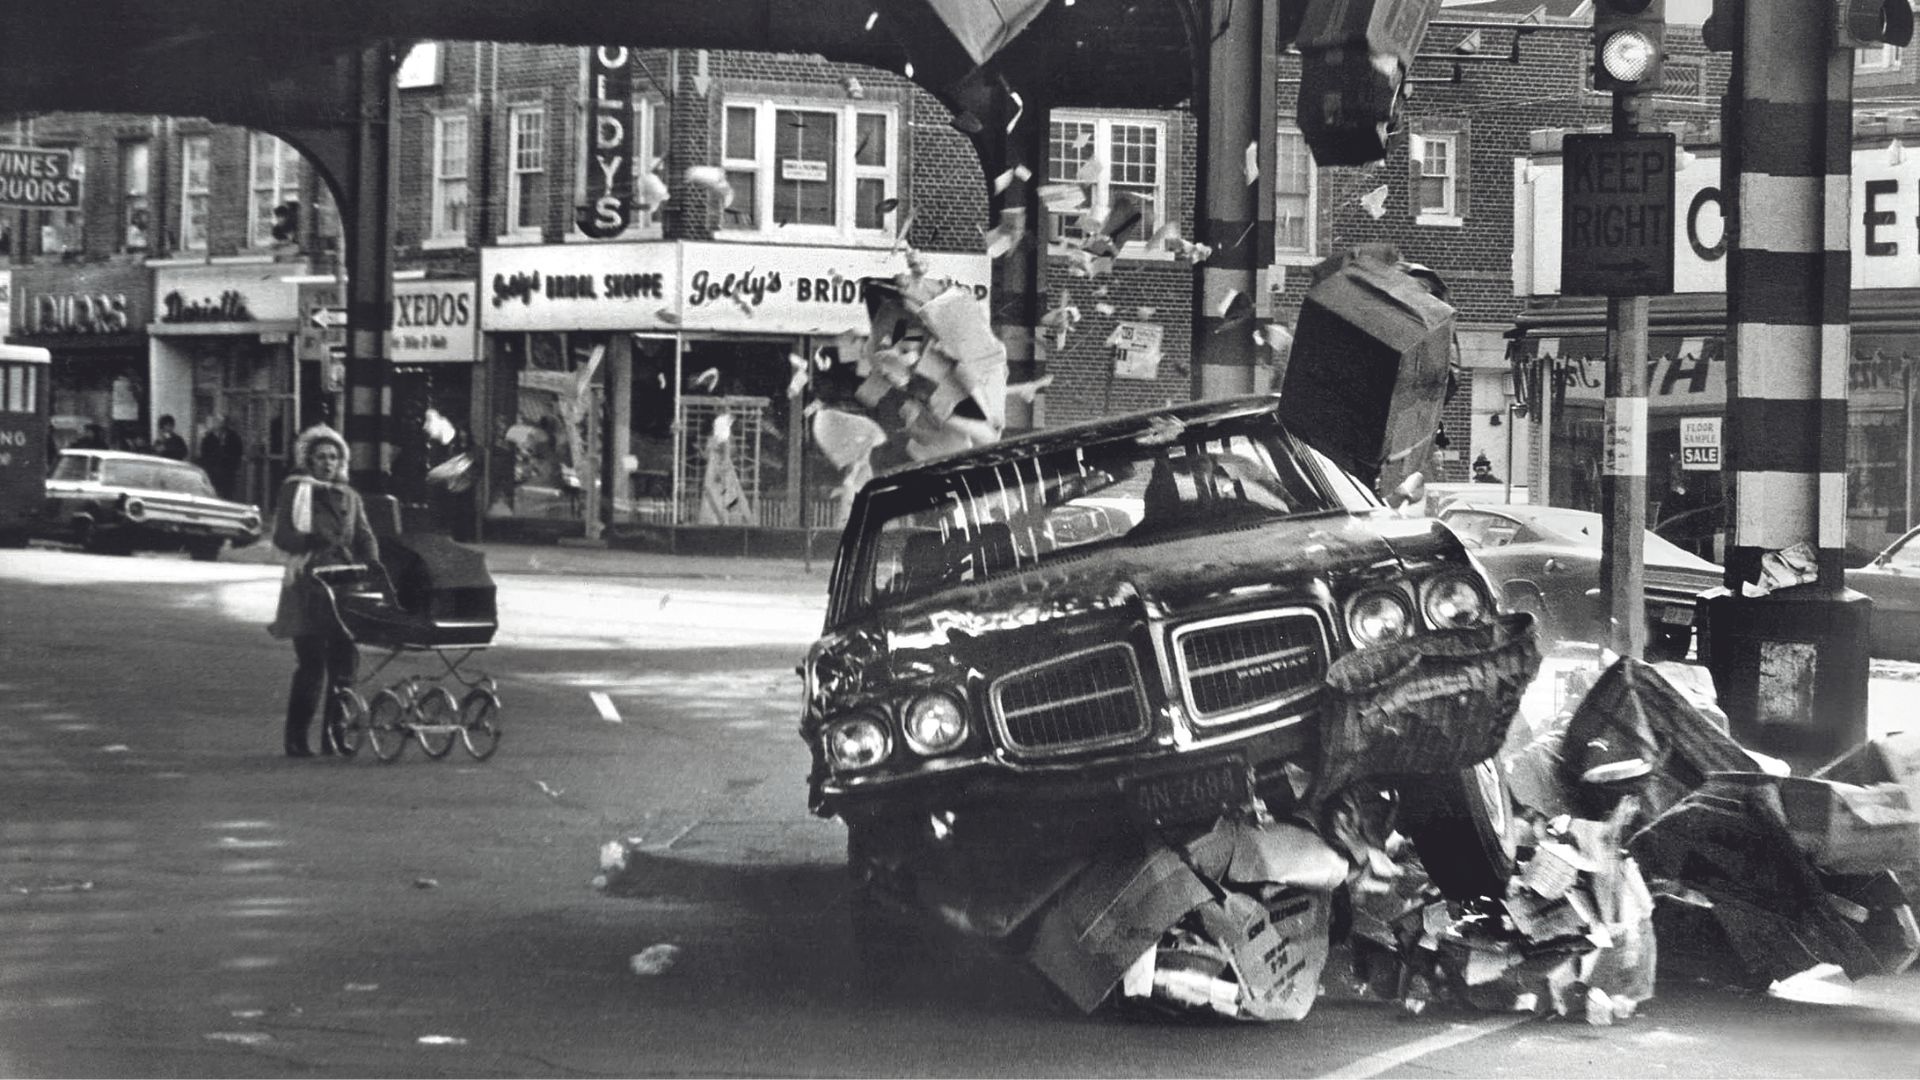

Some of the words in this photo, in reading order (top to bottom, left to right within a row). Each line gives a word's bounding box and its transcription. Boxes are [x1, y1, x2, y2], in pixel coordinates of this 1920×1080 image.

[1573, 151, 1665, 193] KEEP
[1572, 203, 1666, 247] RIGHT
[545, 274, 597, 300] BRIDAL
[604, 272, 663, 300] SHOPPE
[689, 269, 782, 307] Goldy's
[1684, 434, 1716, 444] SAMPLE
[1686, 422, 1714, 432] FLOOR
[1685, 448, 1717, 462] SALE
